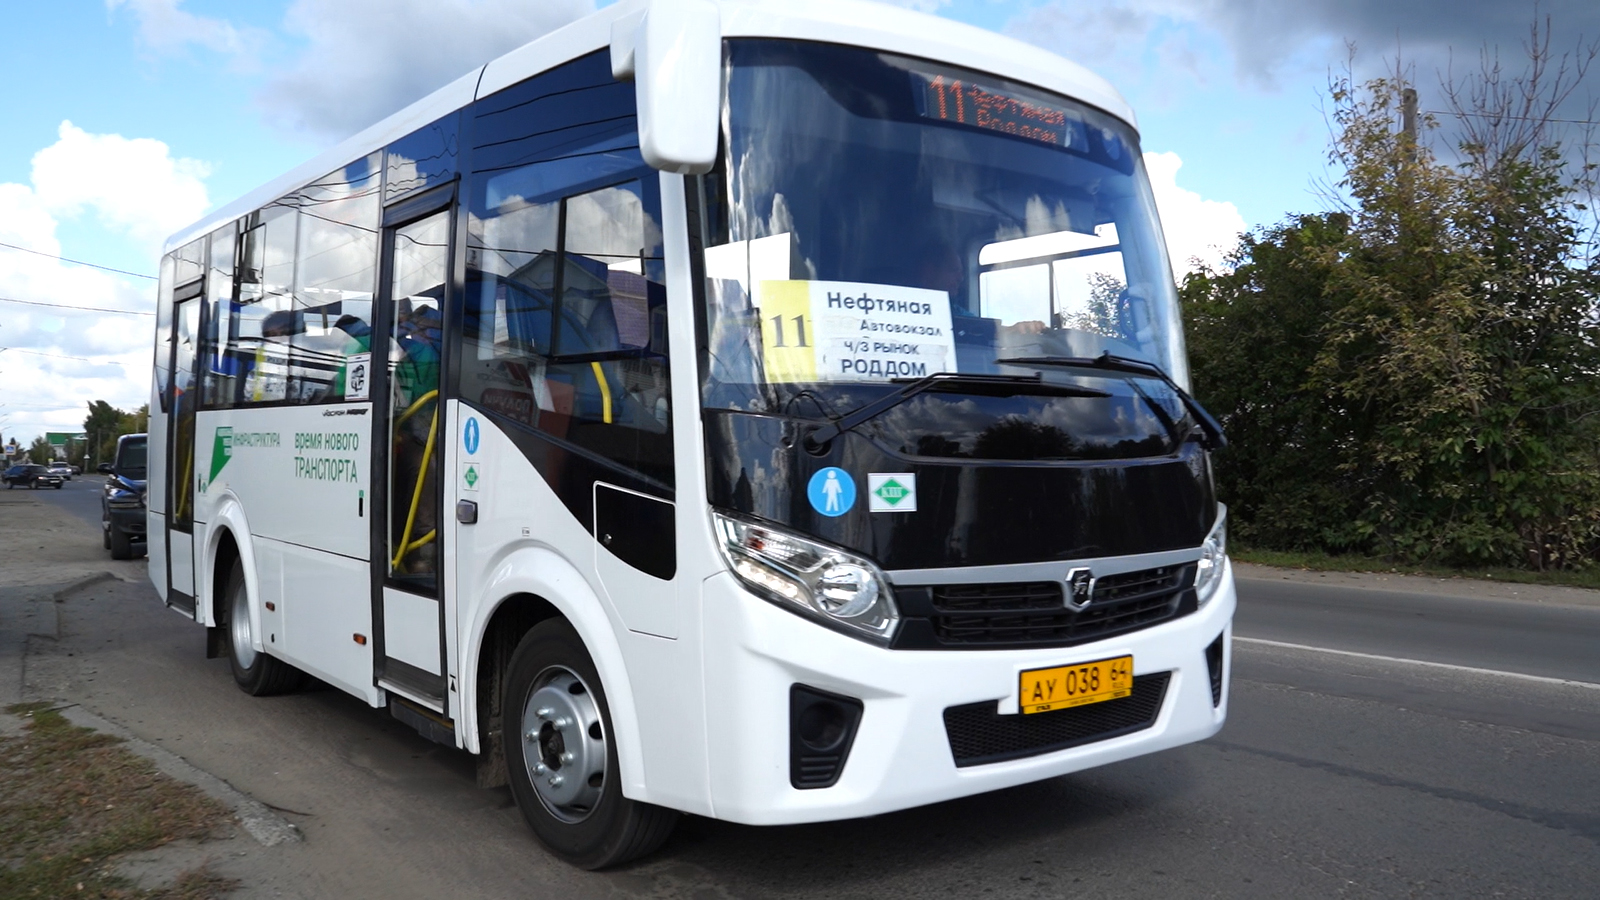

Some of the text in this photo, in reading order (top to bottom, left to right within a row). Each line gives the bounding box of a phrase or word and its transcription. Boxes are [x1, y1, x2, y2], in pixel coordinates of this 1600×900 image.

[929, 74, 965, 123] 11
[827, 291, 932, 315] Нефтяная
[769, 314, 812, 348] 11
[860, 319, 943, 337] Автовокзал
[873, 341, 920, 355] РЫНОК
[841, 358, 927, 378] РОДДОМ
[294, 456, 358, 483] ТРАНСПОРТА
[1033, 661, 1127, 701] АУ 038 64
